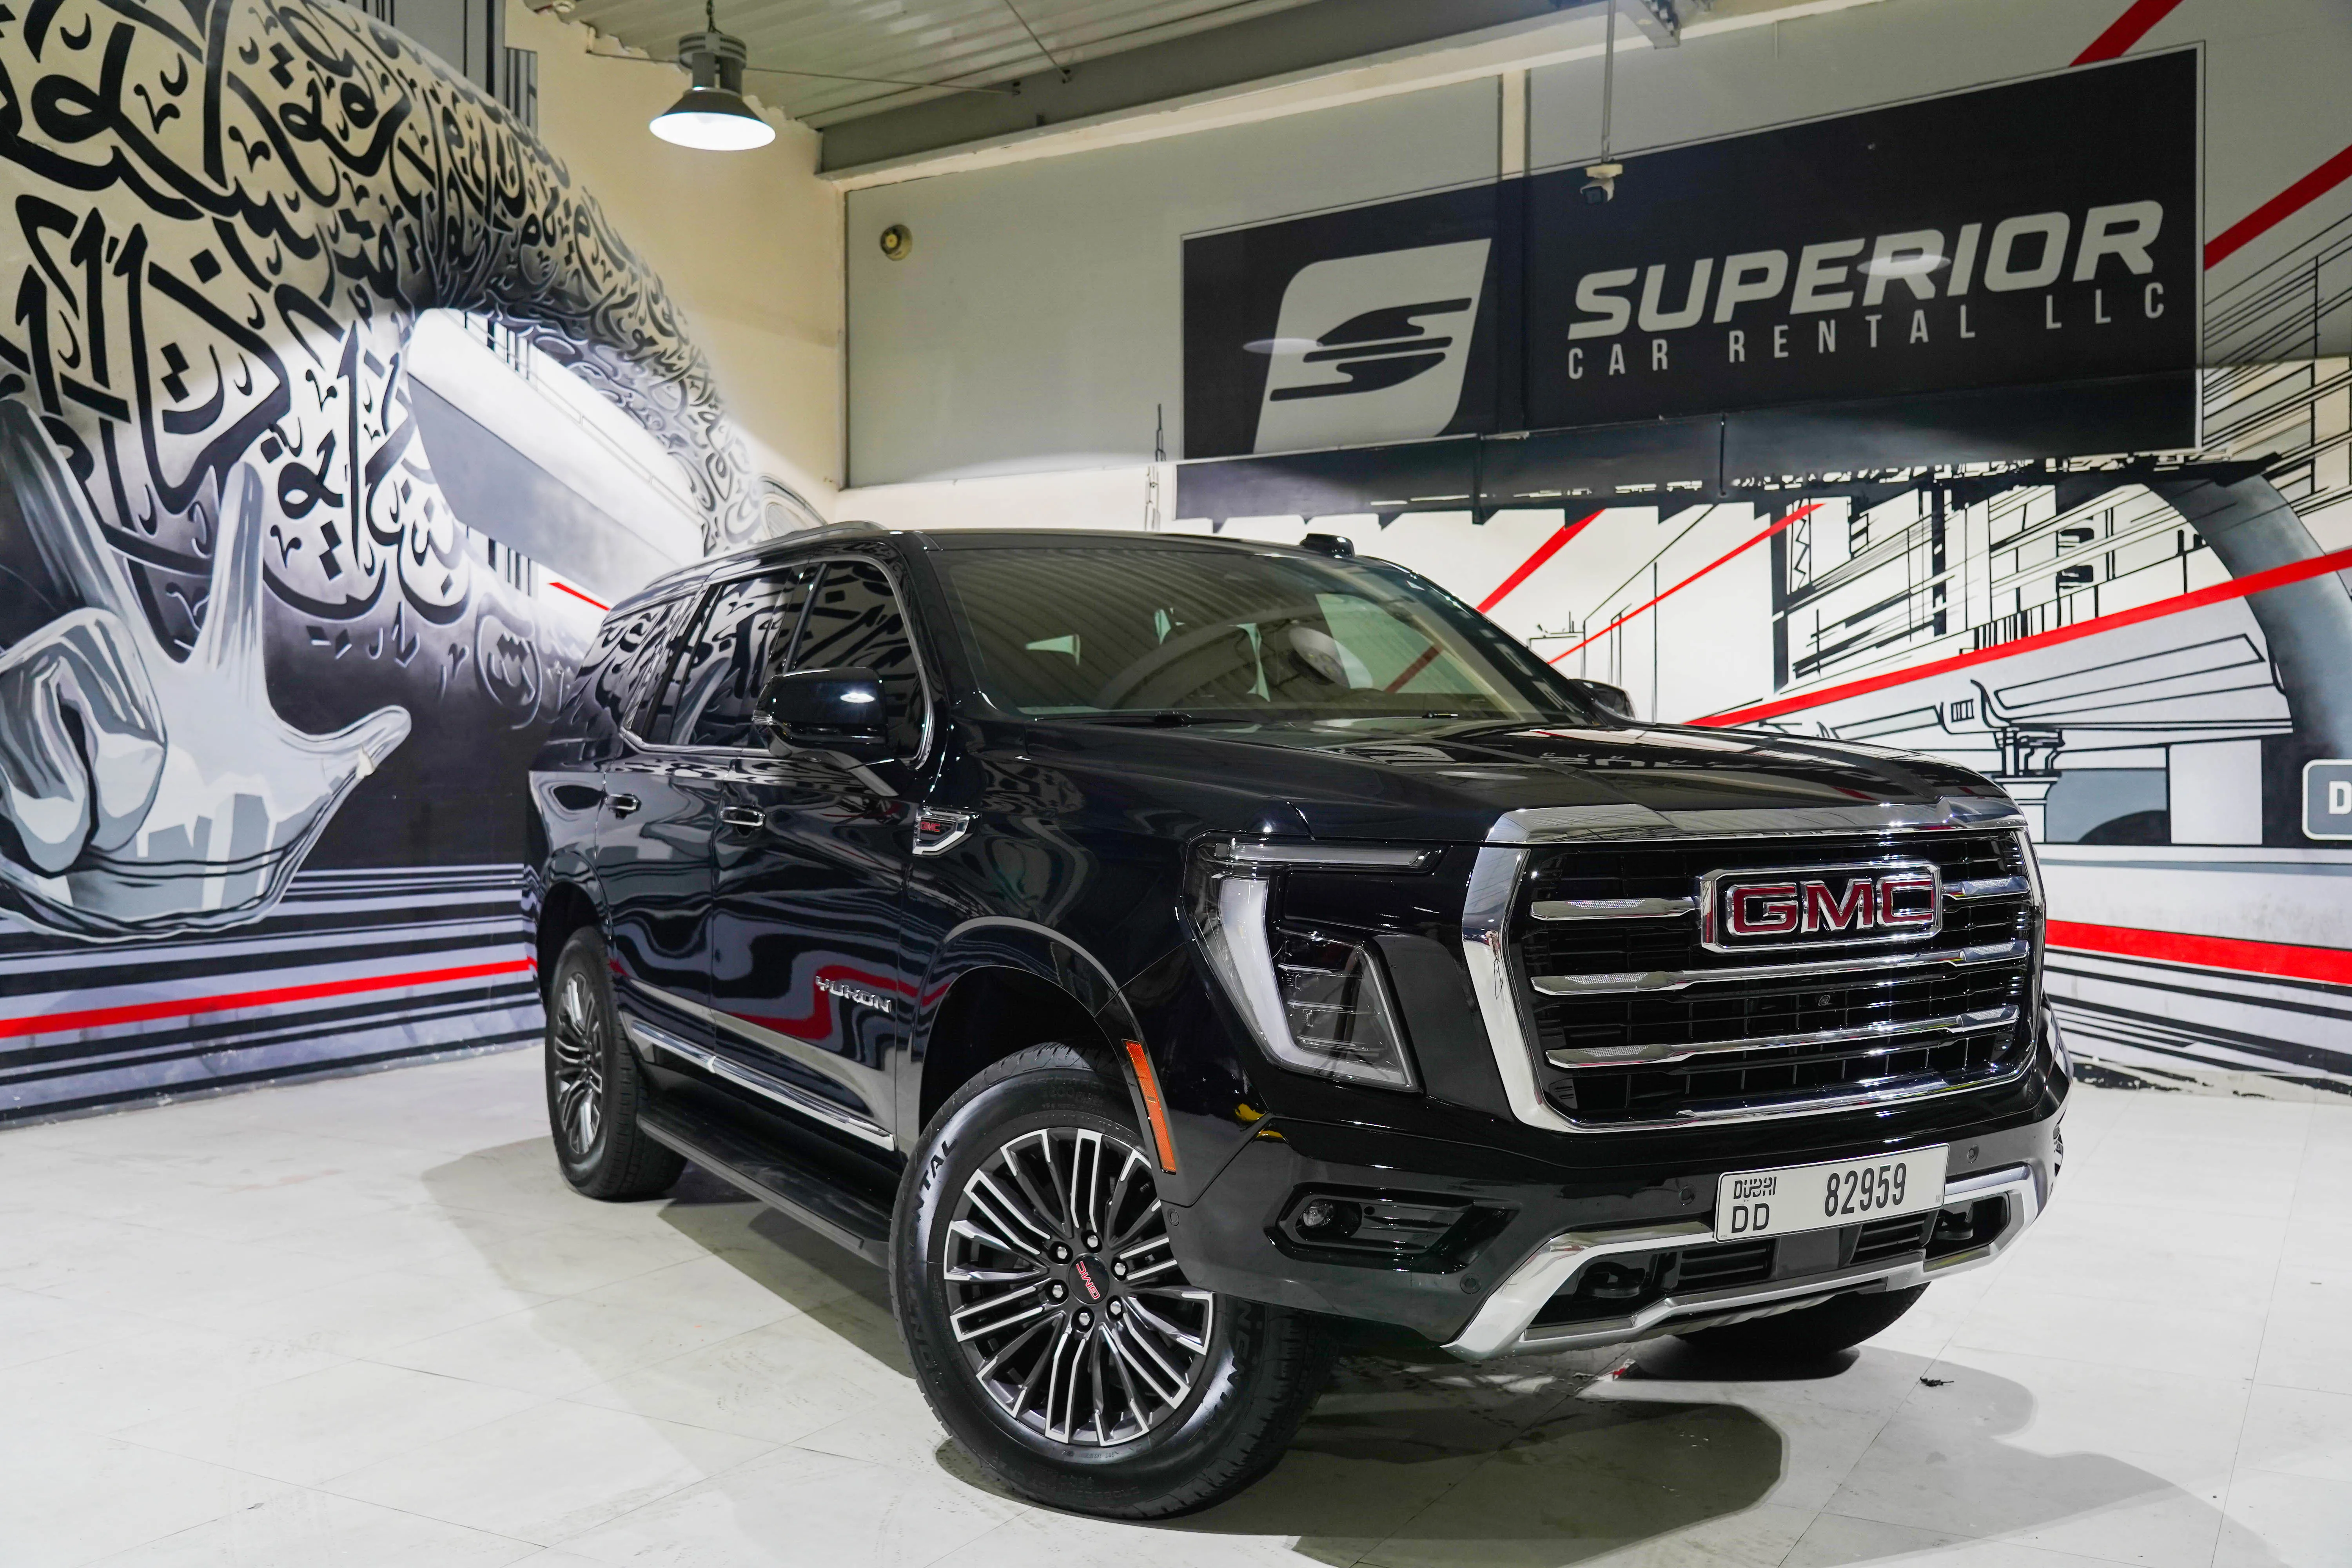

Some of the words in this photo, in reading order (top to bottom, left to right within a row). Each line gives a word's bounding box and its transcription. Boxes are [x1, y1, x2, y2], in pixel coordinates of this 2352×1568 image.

[1568, 200, 2164, 340] SUPERIOR
[1568, 338, 1669, 379] CAR
[1729, 305, 1976, 363] RENTAL
[2045, 282, 2165, 329] LLC
[921, 821, 940, 832] GMC
[1726, 874, 1934, 936] GMC
[815, 976, 892, 1013] YUKON
[1824, 1162, 1907, 1217] 82959
[1731, 1203, 1769, 1234] DD
[1075, 1260, 1101, 1299] GMC
